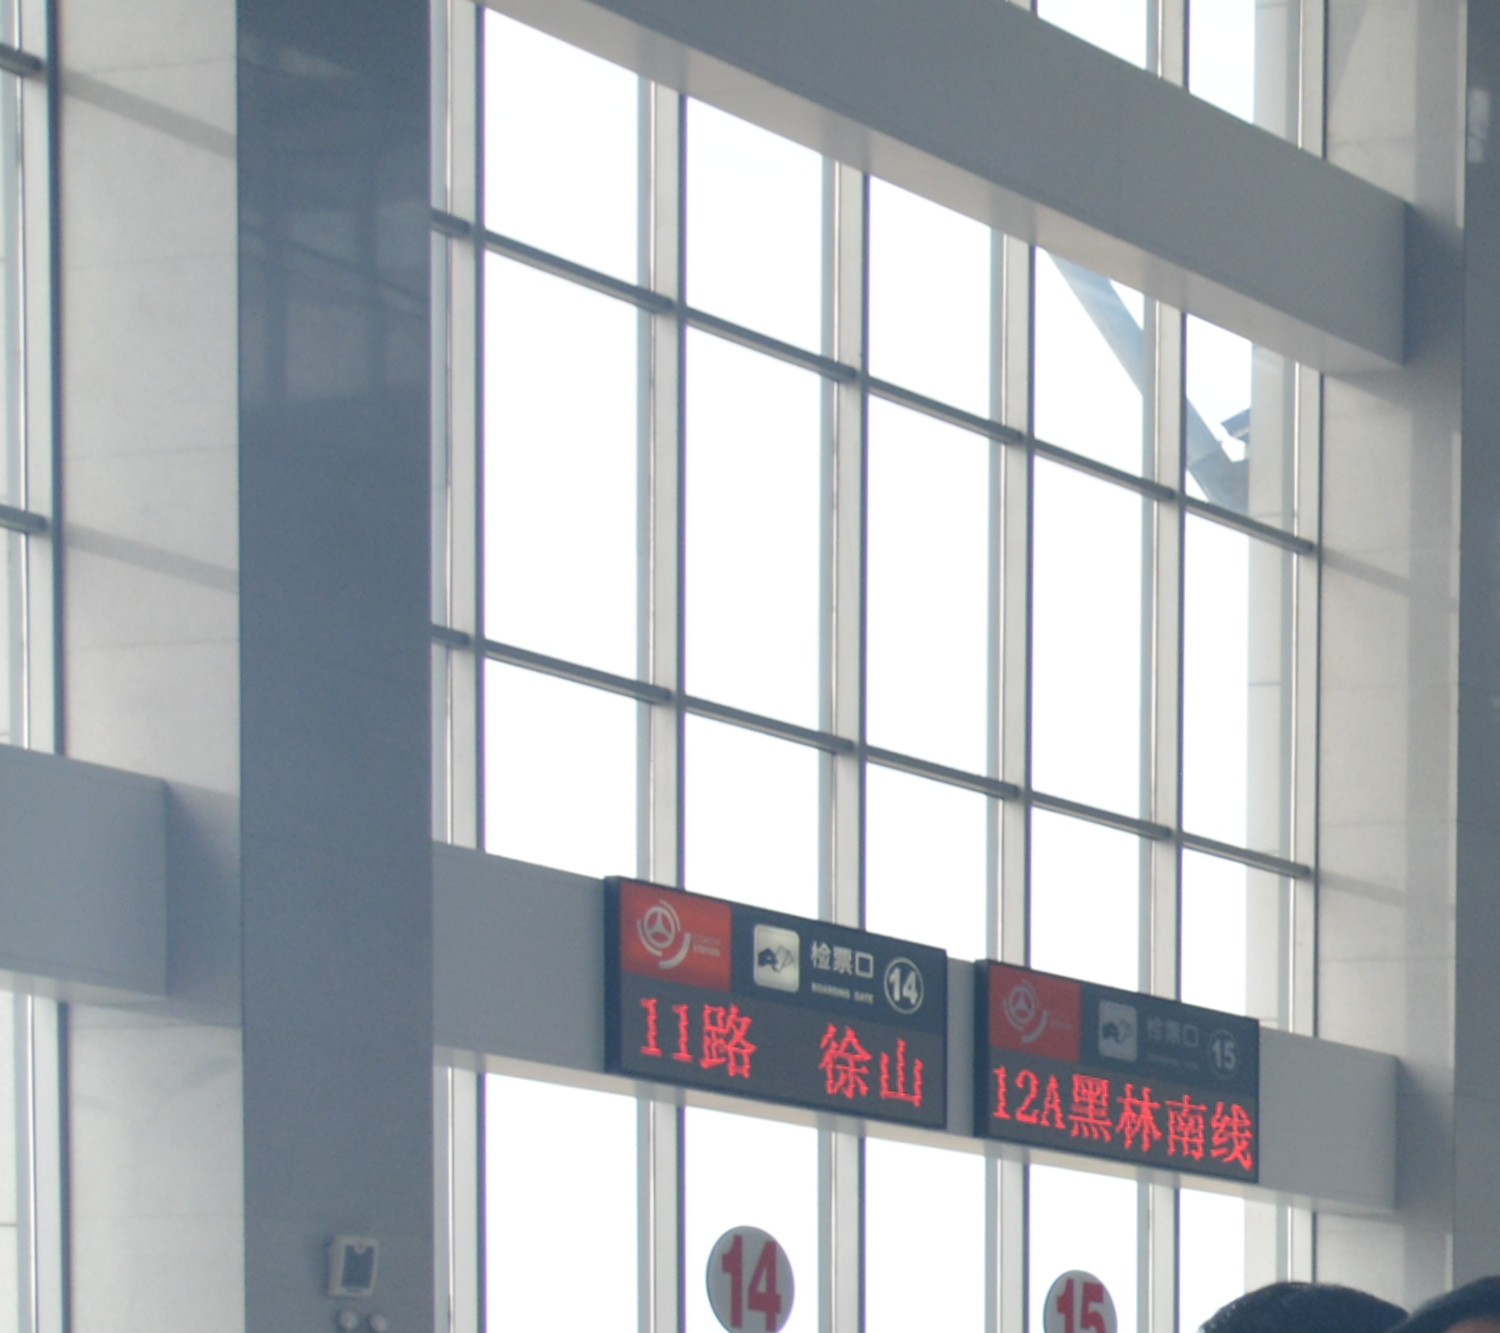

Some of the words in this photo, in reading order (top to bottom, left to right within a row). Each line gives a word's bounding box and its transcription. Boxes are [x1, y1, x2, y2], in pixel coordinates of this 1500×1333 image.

[811, 941, 874, 979] 检票口
[888, 968, 919, 1005] 14
[640, 997, 757, 1079] 11路
[819, 1022, 924, 1107] 徐山
[1211, 1038, 1237, 1070] 15
[993, 1066, 1254, 1171] 12A黑林南线
[722, 1234, 782, 1333] 14
